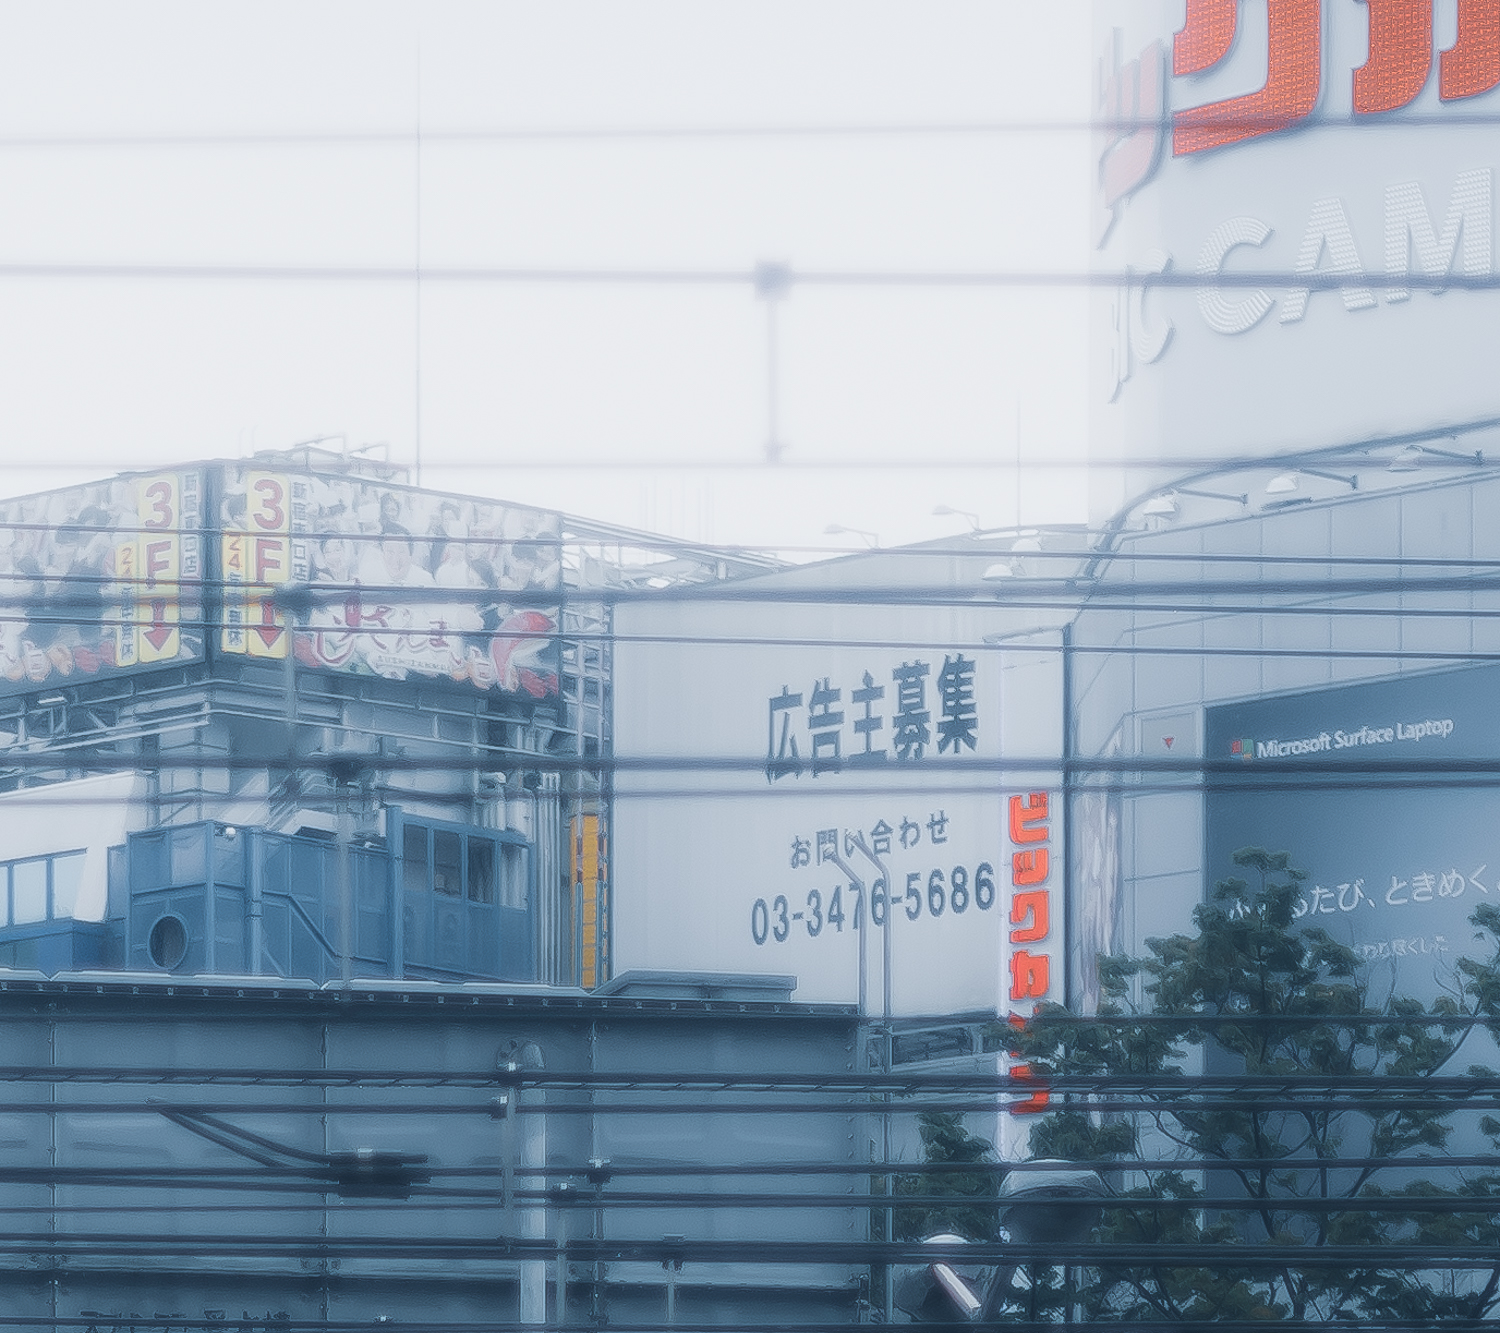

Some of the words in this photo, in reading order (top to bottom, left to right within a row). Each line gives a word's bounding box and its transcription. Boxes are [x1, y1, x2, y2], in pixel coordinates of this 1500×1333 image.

[764, 652, 979, 785] 広告主募集
[1257, 734, 1332, 759] Microsoft
[1333, 726, 1393, 748] Surface
[1396, 718, 1455, 743] Laptop
[789, 809, 949, 869] お問い合わせ
[750, 862, 996, 946] 03-3476-5686
[1009, 792, 1050, 1114] ビックカ
